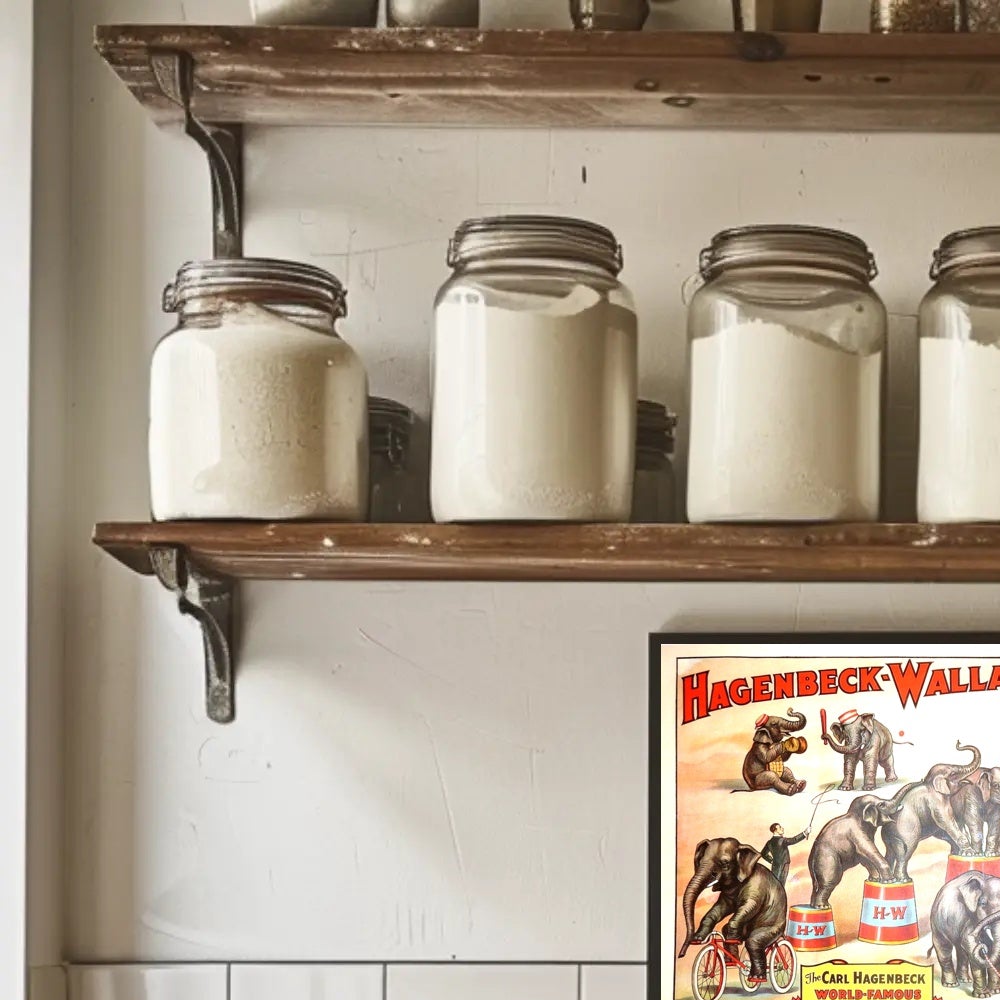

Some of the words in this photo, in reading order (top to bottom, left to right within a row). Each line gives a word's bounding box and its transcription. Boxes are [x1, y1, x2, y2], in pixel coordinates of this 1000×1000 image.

[873, 906, 907, 920] H-W
[796, 925, 827, 936] H-W
[805, 972, 821, 985] The
[822, 971, 850, 985] CARL
[853, 971, 926, 985] HAGENBECK
[814, 989, 922, 1000] WORLD-FAMOUS
